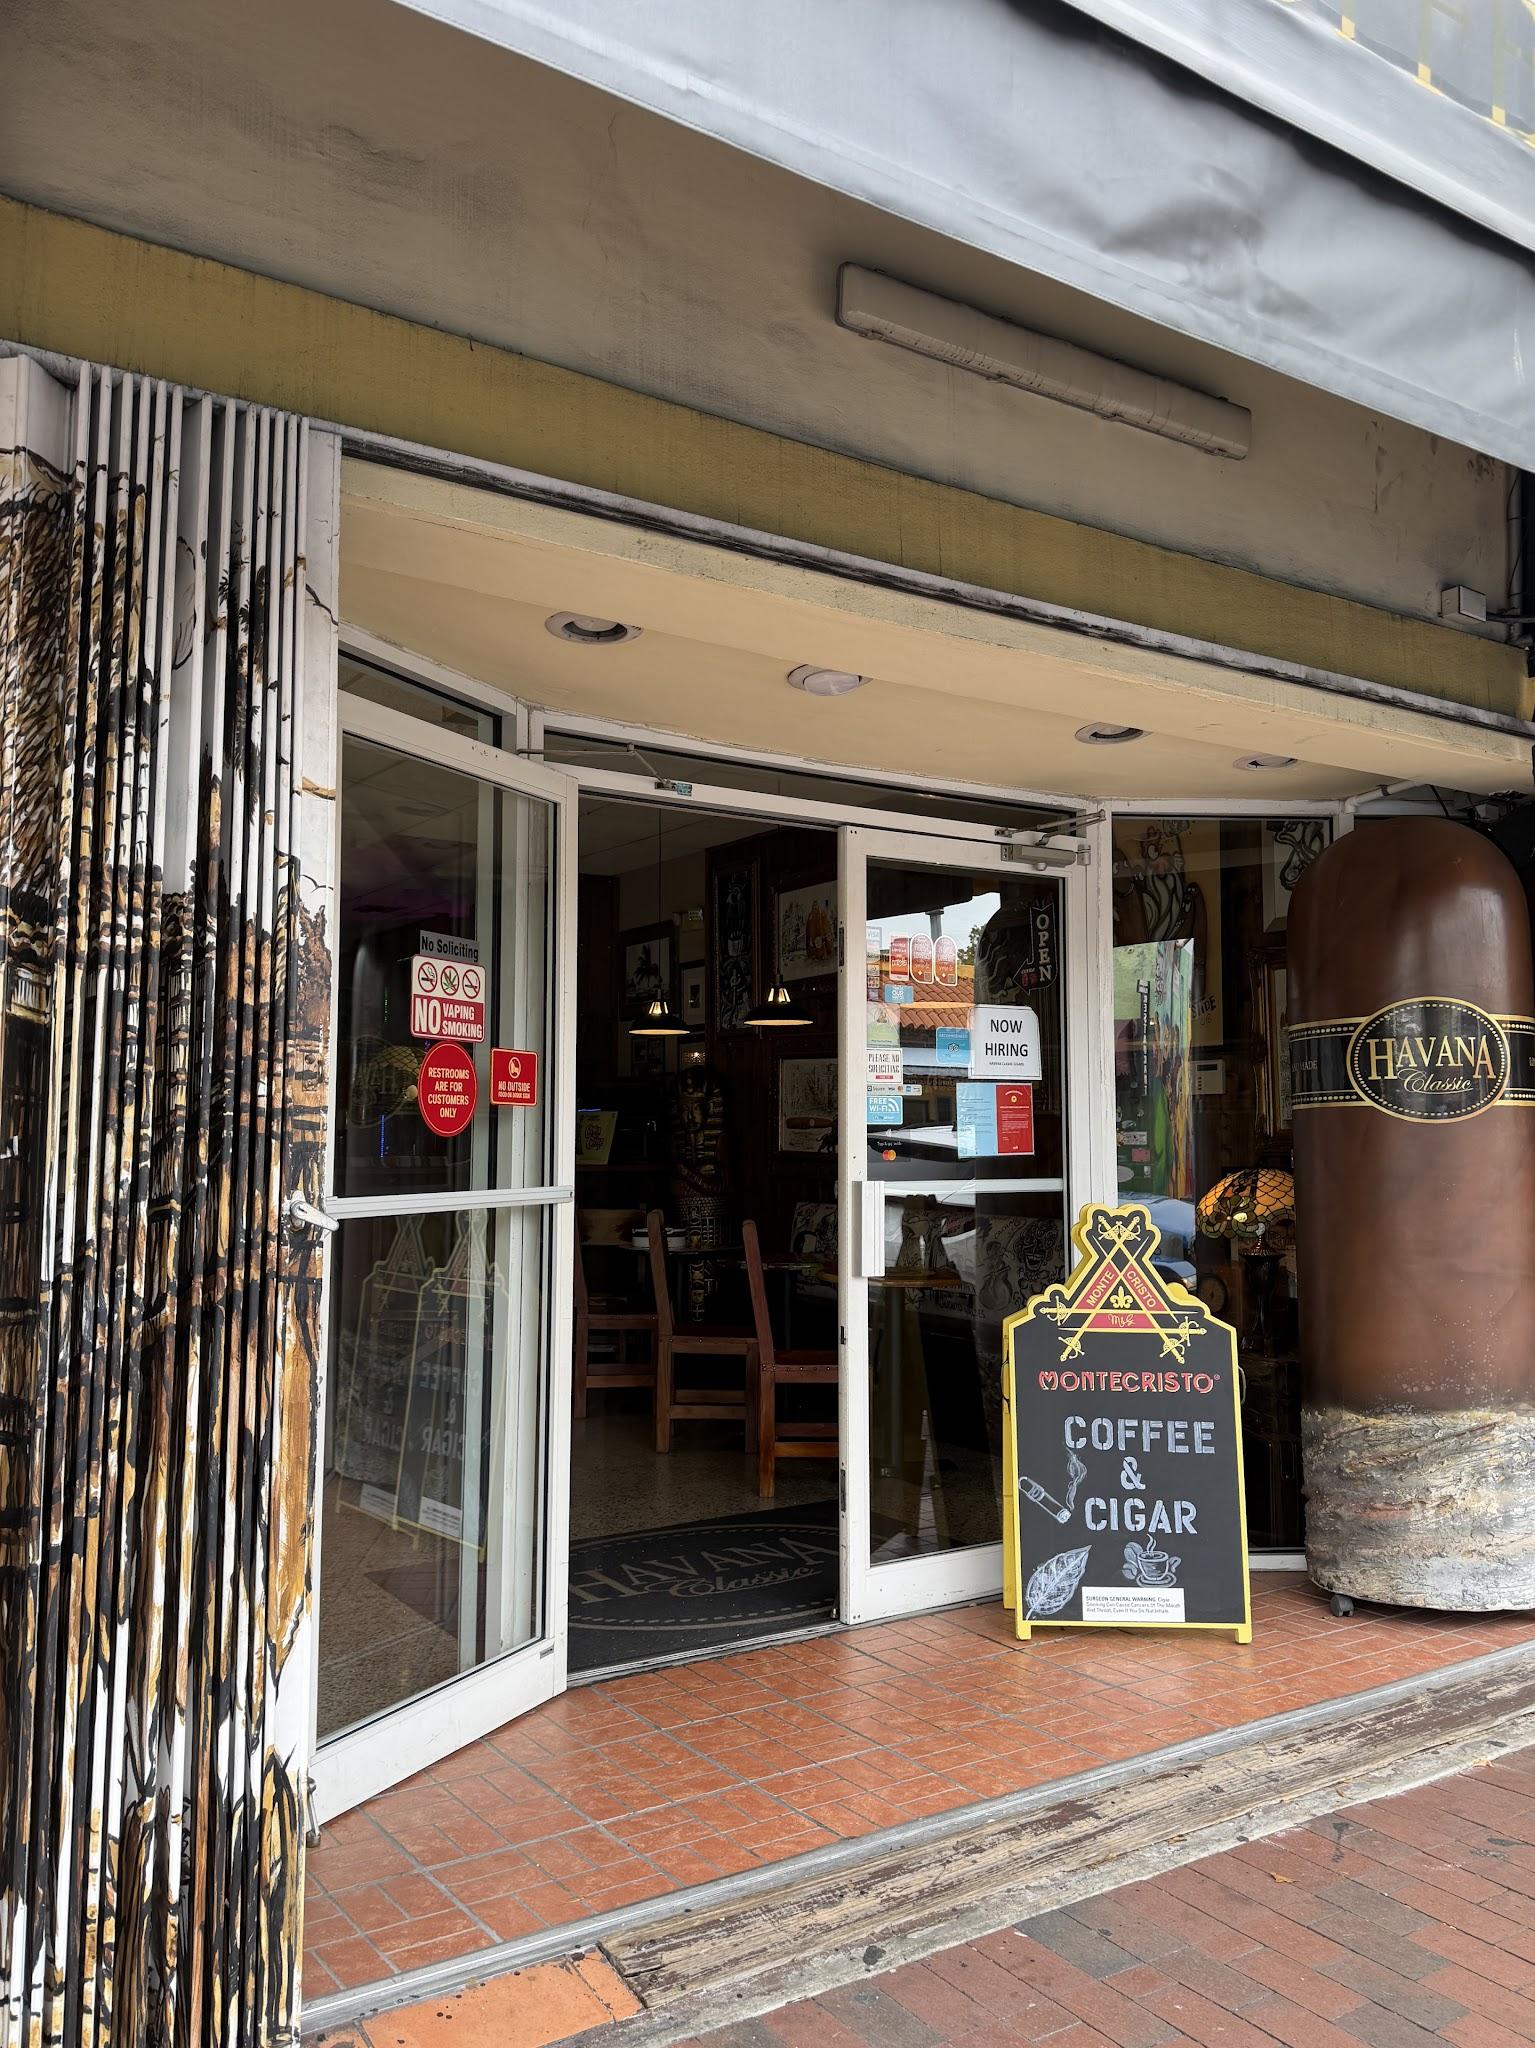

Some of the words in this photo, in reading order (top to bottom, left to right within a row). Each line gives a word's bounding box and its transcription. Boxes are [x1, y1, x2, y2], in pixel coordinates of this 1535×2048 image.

[421, 935, 434, 952] No
[437, 939, 479, 963] Soliciting
[1036, 914, 1052, 982] OPEN
[414, 998, 442, 1035] NO
[443, 1003, 475, 1021] VAPING
[442, 1021, 483, 1039] SMOKING
[990, 1019, 1023, 1033] NOW
[868, 1053, 890, 1063] PLEASE
[892, 1054, 900, 1063] NO
[985, 1042, 1028, 1057] HIRING
[1366, 1034, 1496, 1081] HAVANA
[428, 1067, 470, 1081] RESTROOMS
[868, 1064, 900, 1074] SOLICITING
[1397, 1068, 1474, 1095] Classic
[428, 1093, 469, 1105] CUSTOMERS
[434, 1081, 448, 1092] ARE
[450, 1081, 463, 1092] FOR
[498, 1081, 507, 1091] NO
[508, 1082, 530, 1092] OUTSIDE
[440, 1107, 457, 1118] ONLY
[1086, 1270, 1115, 1306] MONTE
[1127, 1270, 1156, 1307] CRISTO
[1064, 1415, 1216, 1455] COFFEE
[1120, 1457, 1146, 1490] &
[1084, 1497, 1198, 1535] CIGAR
[569, 1537, 839, 1605] HAVANA
[644, 1567, 823, 1598] Classic
